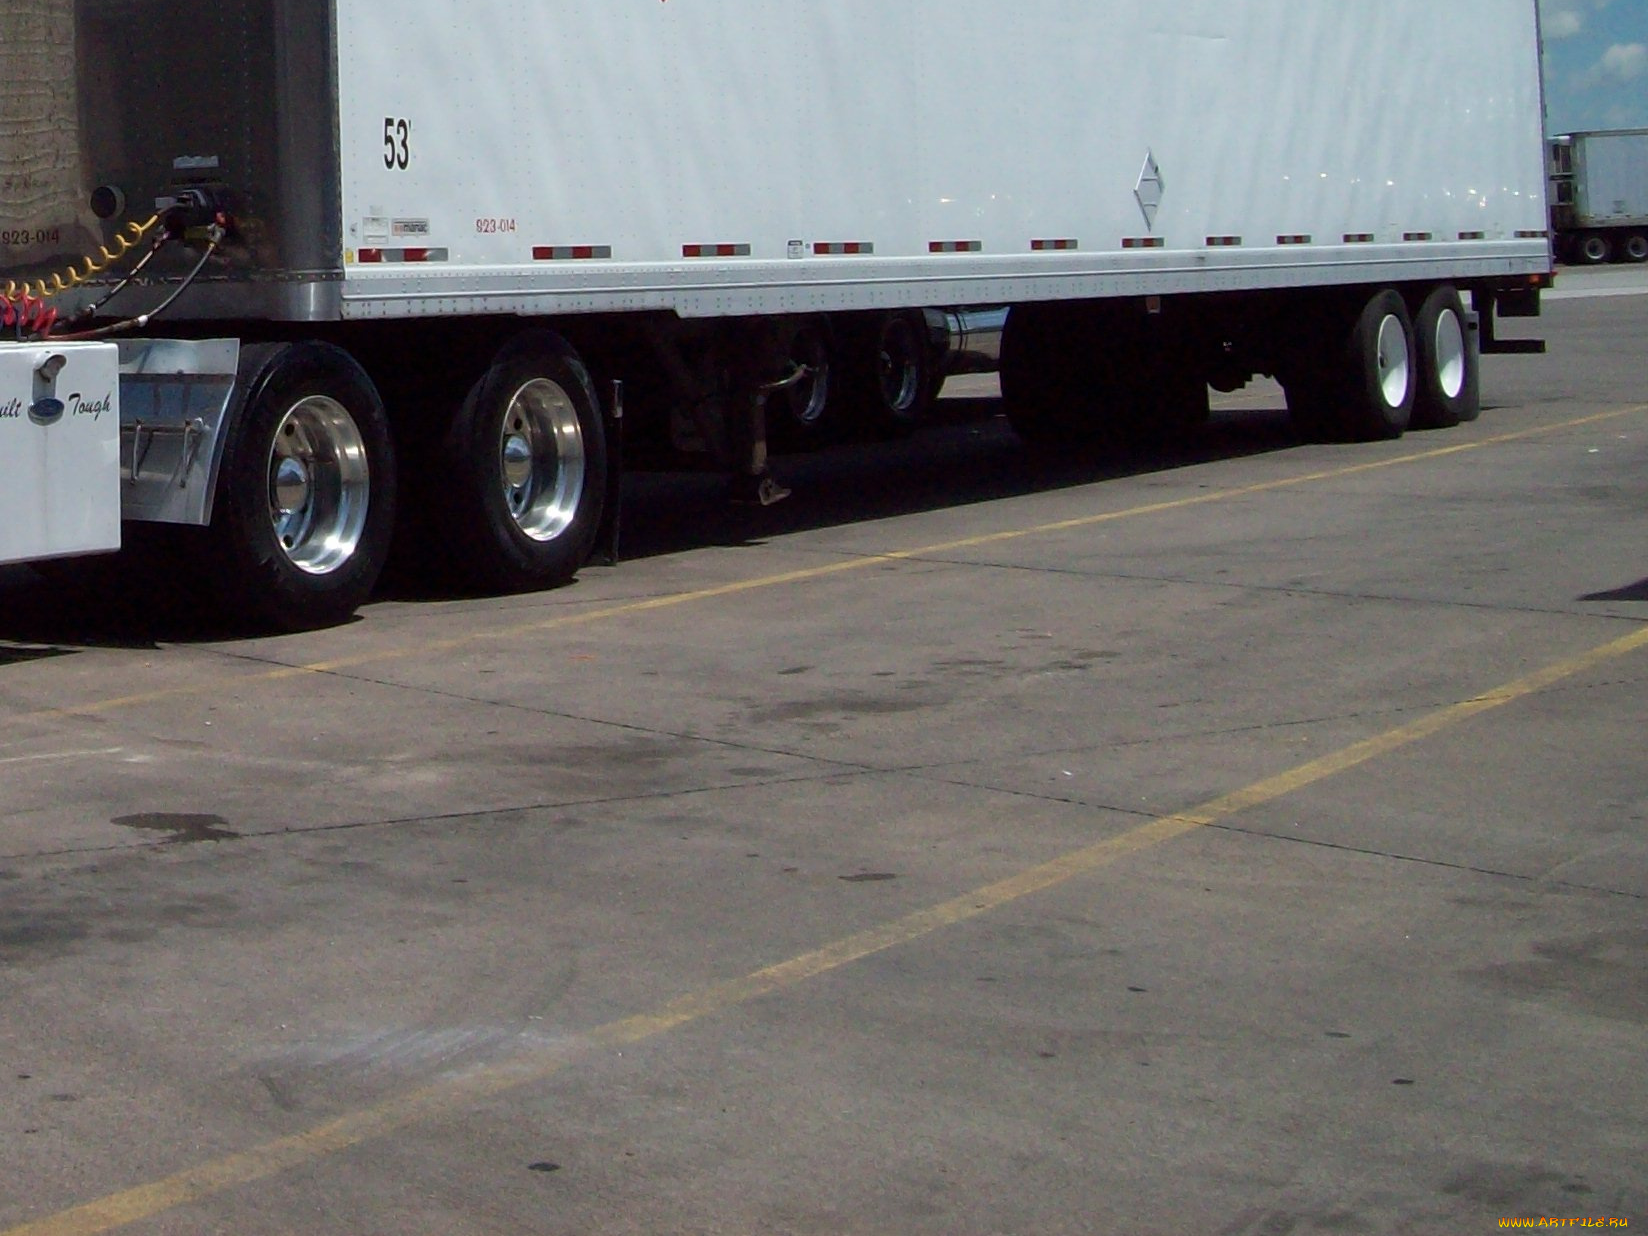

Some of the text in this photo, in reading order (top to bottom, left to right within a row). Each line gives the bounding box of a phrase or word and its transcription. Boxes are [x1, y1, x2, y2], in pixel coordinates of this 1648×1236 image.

[475, 218, 517, 234] 923-014
[2, 229, 60, 245] 923-014
[68, 391, 112, 422] Tough
